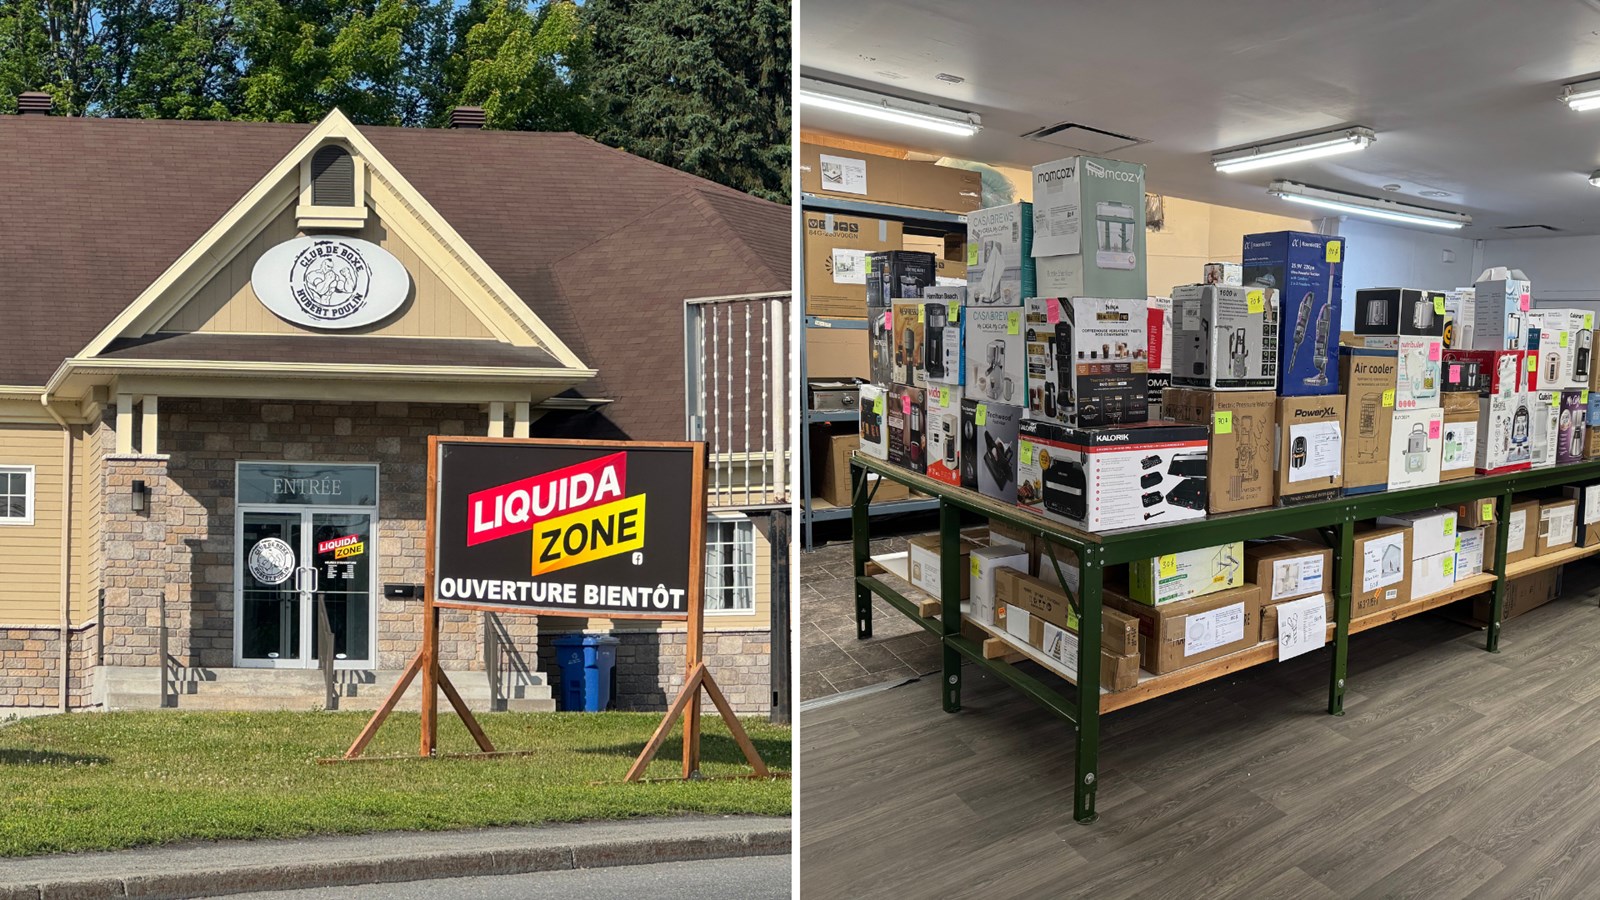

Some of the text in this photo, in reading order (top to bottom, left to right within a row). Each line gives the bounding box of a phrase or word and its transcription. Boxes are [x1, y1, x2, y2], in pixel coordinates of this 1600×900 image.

[1037, 166, 1076, 184] momcozy
[300, 245, 364, 272] CLUB DE BOXE
[296, 289, 364, 317] HUBERT POULIN
[1354, 363, 1394, 374] Air cooler
[987, 411, 1012, 421] Techwood
[1294, 406, 1336, 418] PowerXL
[1096, 433, 1129, 442] KALORIK
[273, 476, 342, 495] ENTRÉE
[474, 465, 622, 533] LIQUIDA
[320, 536, 357, 551] LIQUIDA
[539, 508, 638, 563] ZONE
[337, 545, 362, 557] ZONE
[440, 577, 685, 609] OUVERTURE BIENTÔT
